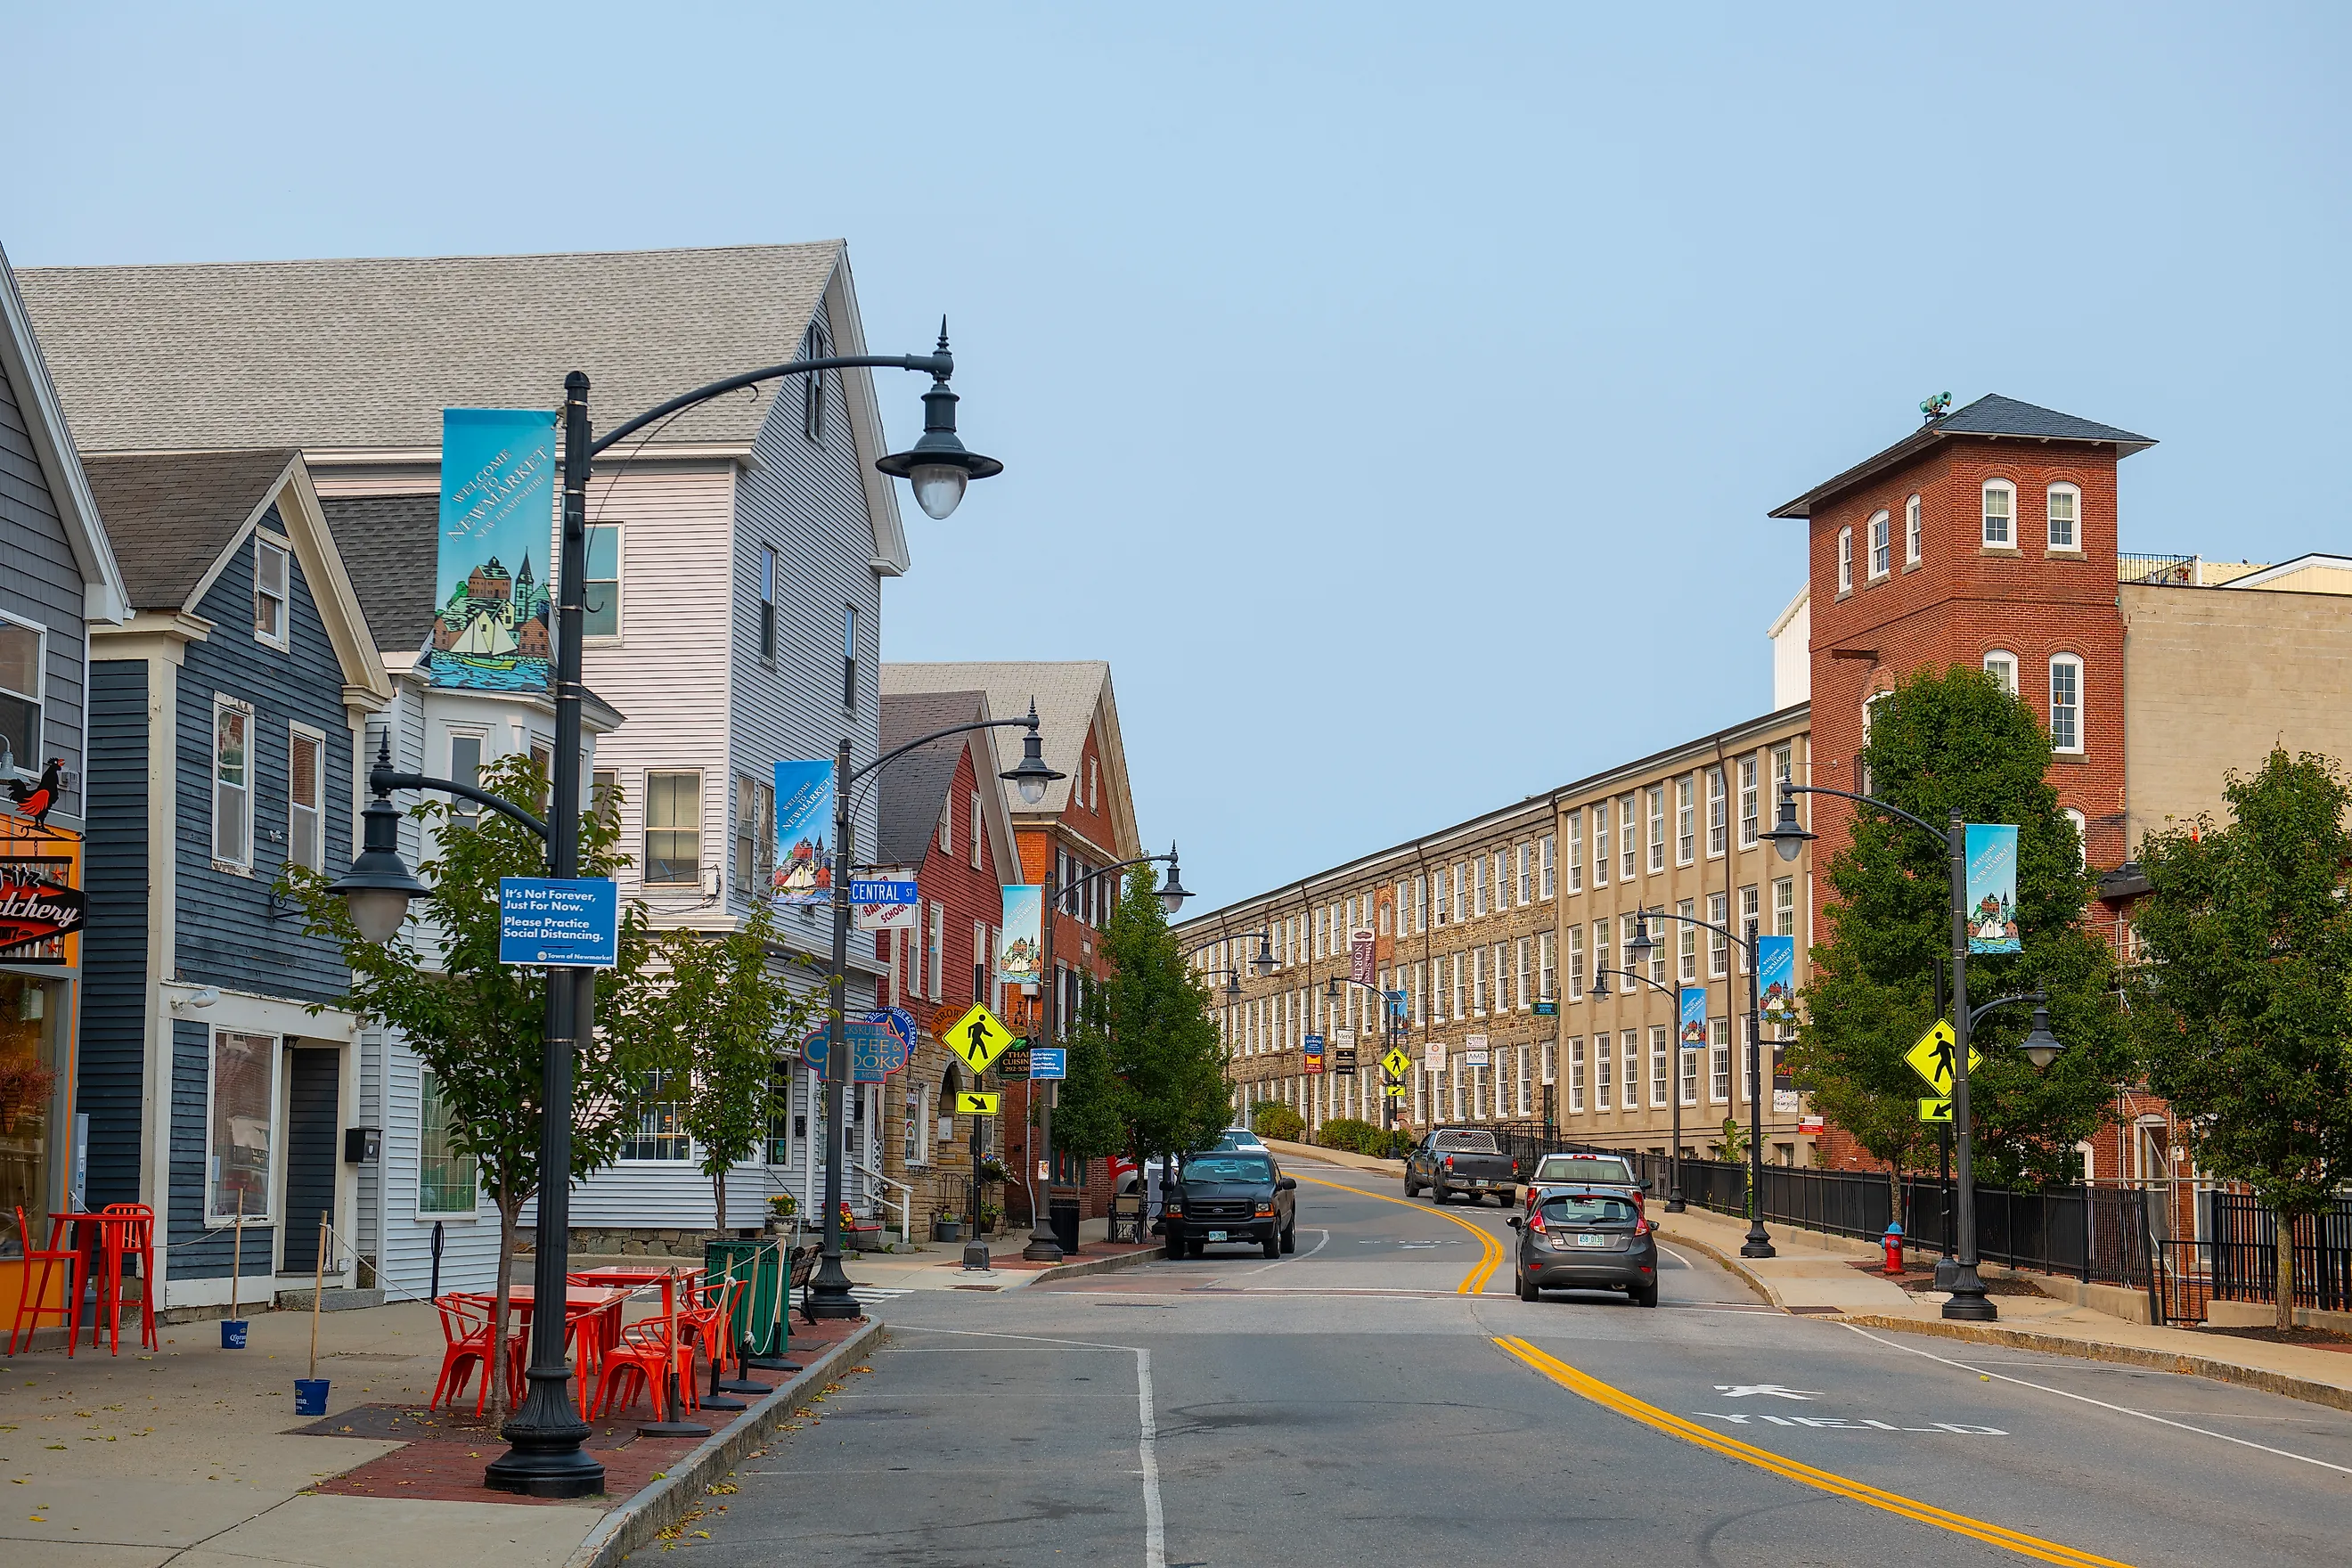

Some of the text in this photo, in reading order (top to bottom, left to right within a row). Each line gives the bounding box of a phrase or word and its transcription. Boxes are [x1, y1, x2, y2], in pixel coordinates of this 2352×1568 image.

[452, 448, 512, 503] WELCOME
[479, 477, 499, 493] TO
[446, 444, 549, 543] NEWMARKET
[474, 474, 547, 541] NEW HAMPSHIRE
[783, 780, 813, 812] WELCOME
[797, 795, 807, 805] TO
[782, 778, 830, 831] NEWMARKET
[1971, 841, 2014, 886] NEWMARKET
[505, 889, 596, 902] It's Not Forever,
[852, 884, 913, 900] CENTRAL ST
[504, 900, 584, 911] Just For Now.
[503, 917, 590, 928] Please Practice
[503, 928, 604, 943] Social Distancing.
[1354, 944, 1363, 981] NORTH
[1364, 962, 1372, 983] Street
[933, 1009, 961, 1025] BROW
[824, 1024, 887, 1036] CCKSKULL'S
[892, 1041, 902, 1051] &
[1692, 1411, 2010, 1435] YIELD
